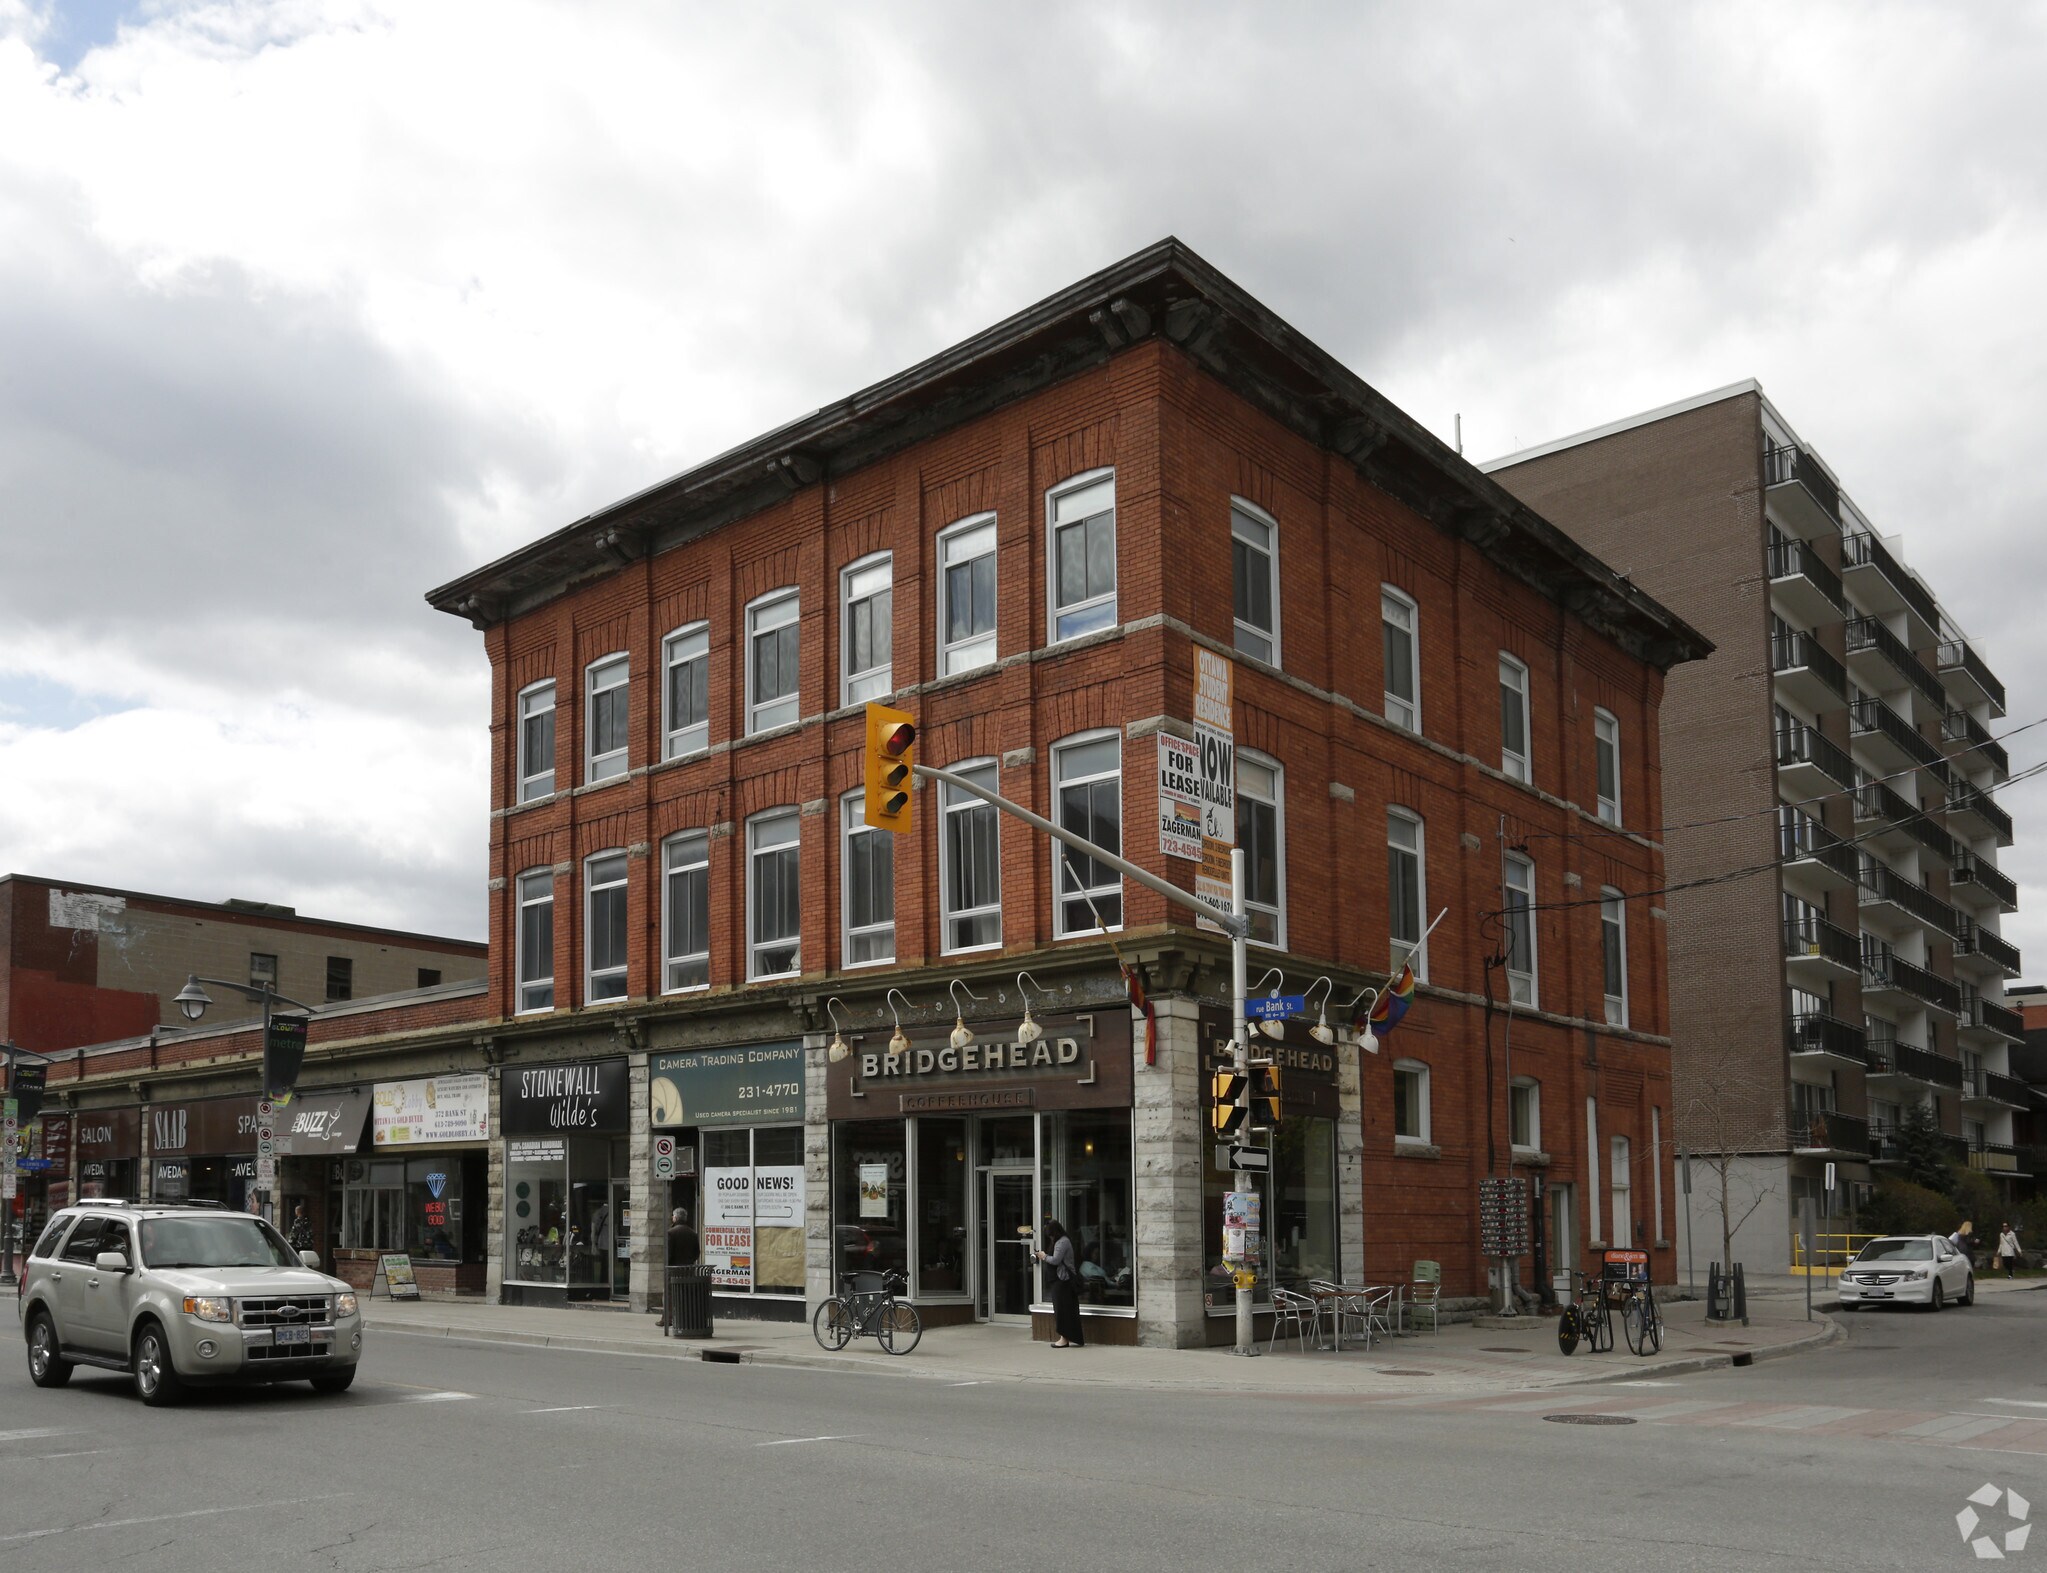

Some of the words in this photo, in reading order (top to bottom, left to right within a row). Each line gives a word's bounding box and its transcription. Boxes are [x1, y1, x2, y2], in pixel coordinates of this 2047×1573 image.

[1199, 672, 1229, 706] STUDENT
[1195, 693, 1232, 730] RESIDENCE
[1161, 735, 1181, 752] OFFICE
[1181, 741, 1200, 758] SPACE
[1168, 750, 1194, 774] FOR
[1196, 731, 1232, 787] NOW
[1162, 769, 1200, 798] LEASE
[1200, 777, 1232, 809] VAILABLE
[1162, 818, 1201, 841] ZAGERMAN
[1162, 838, 1202, 859] 723-4545
[1265, 999, 1284, 1013] Bank
[659, 1058, 698, 1071] CAMERA
[701, 1053, 745, 1067] TRADING
[748, 1048, 800, 1063] COMPANY
[862, 1037, 1079, 1077] BRIDGEHEAD
[521, 1065, 600, 1099] STONEWALL
[738, 1082, 799, 1099] 231-4770
[375, 1089, 394, 1107] GOLD
[906, 1091, 1024, 1109] COFFEEHOUSE
[550, 1095, 598, 1129] Wilde's
[781, 1105, 798, 1114] 1981
[154, 1109, 188, 1151] SAAB
[237, 1115, 258, 1134] SPA
[296, 1111, 328, 1133] BUZZ
[81, 1126, 112, 1144] SALON
[83, 1163, 105, 1176] AVEDA
[158, 1165, 183, 1179] AVEDA
[717, 1177, 749, 1190] GOOD
[756, 1176, 794, 1190] NEWS!
[425, 1203, 435, 1213] WE
[428, 1215, 445, 1226] GOLD
[705, 1226, 736, 1234] COMMERCIAL
[705, 1234, 722, 1246] FOR
[724, 1235, 751, 1247] LEASE
[712, 1277, 751, 1285] 23-4545
